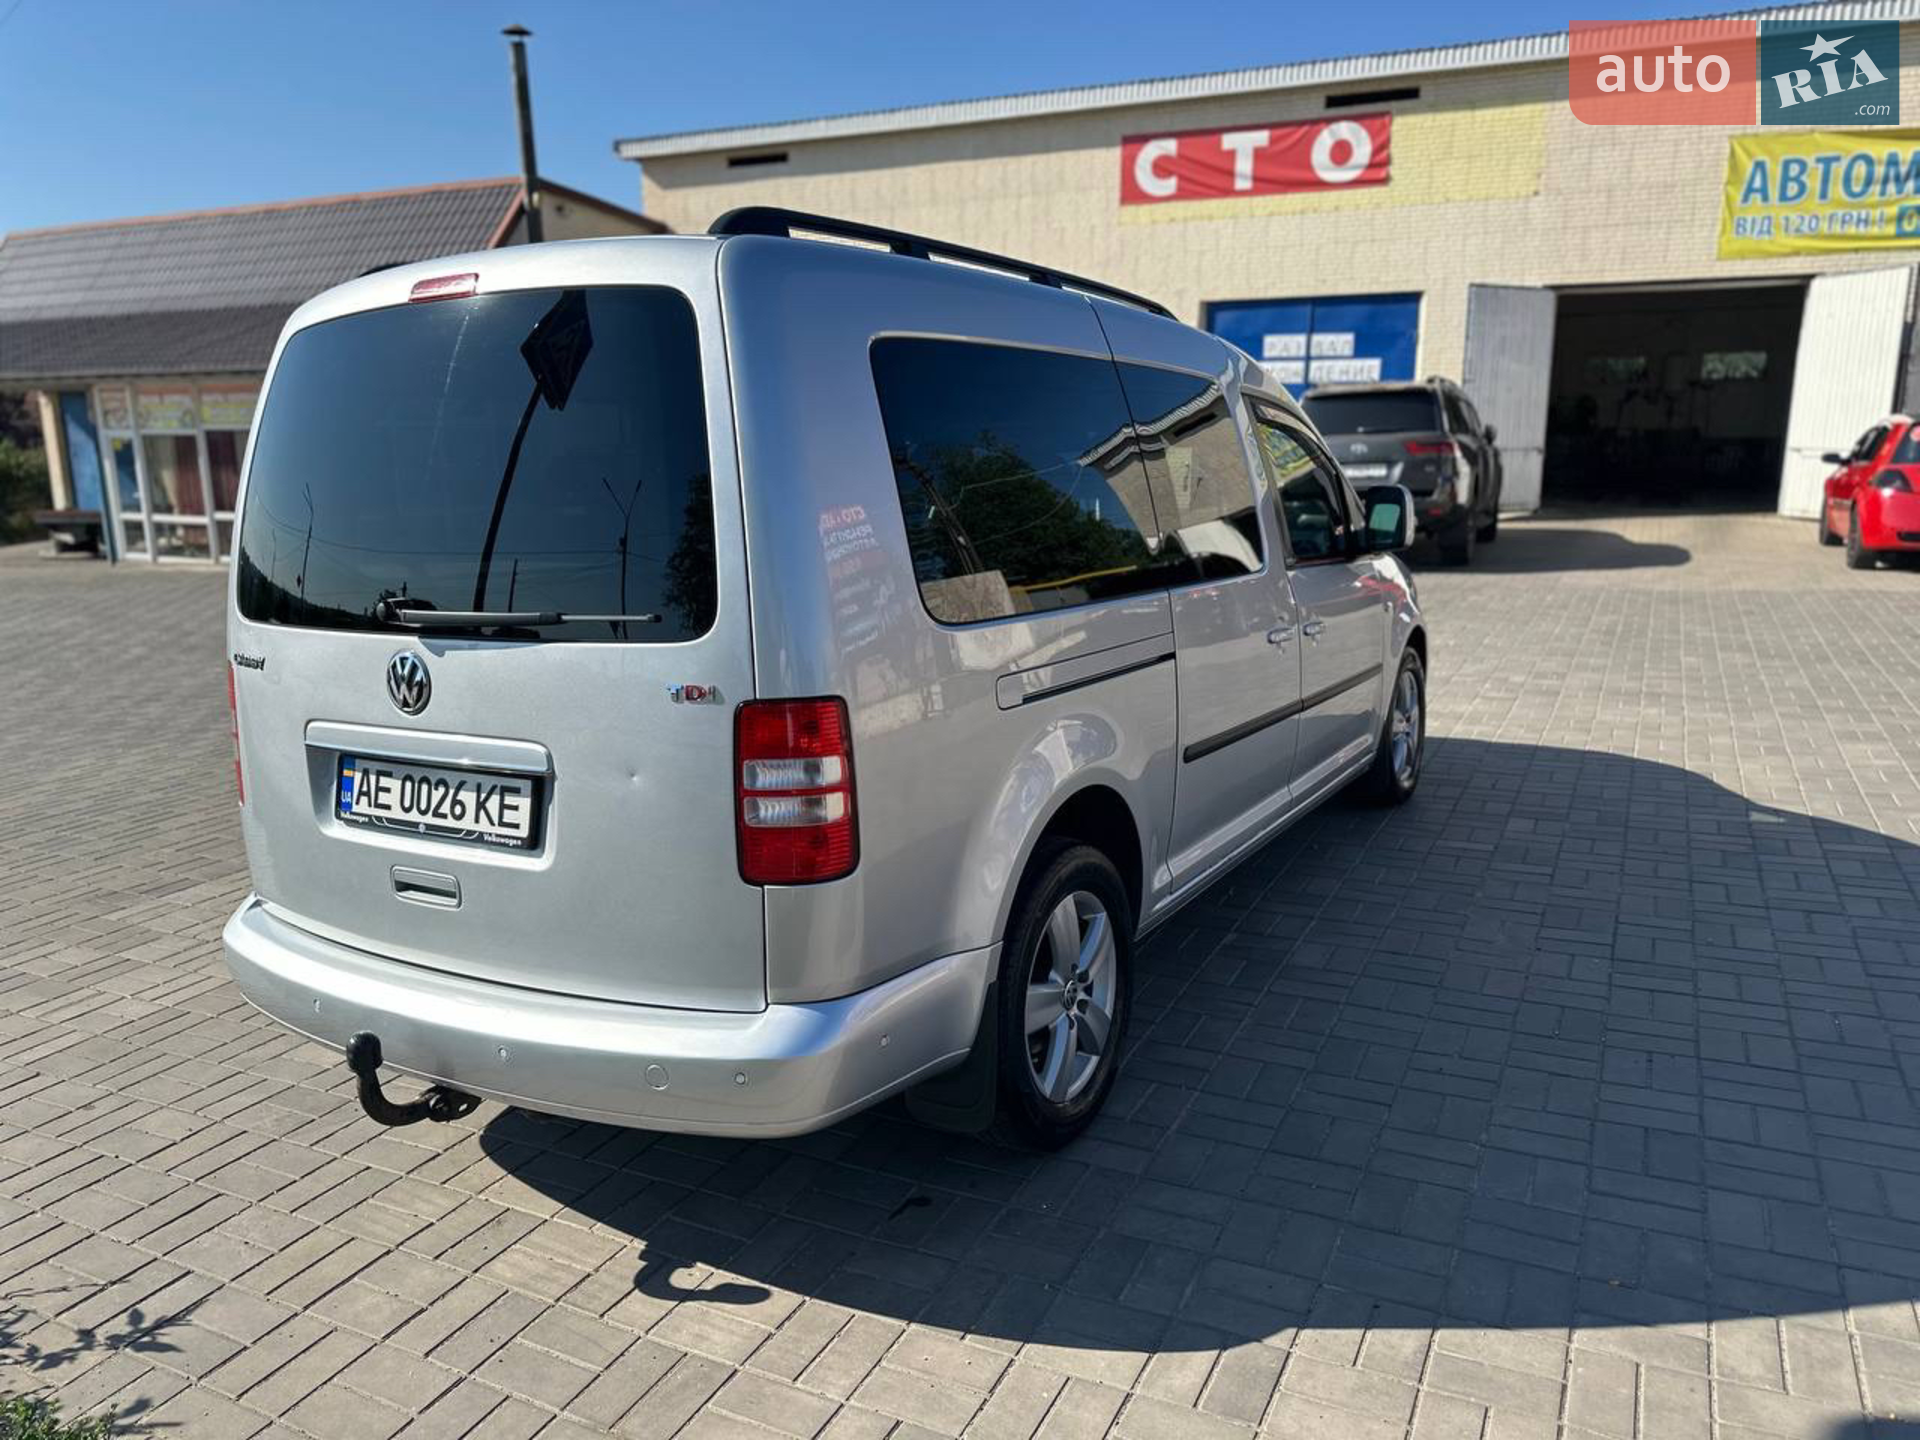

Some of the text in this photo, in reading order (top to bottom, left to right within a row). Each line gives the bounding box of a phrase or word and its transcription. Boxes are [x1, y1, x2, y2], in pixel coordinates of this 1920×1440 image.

[1134, 119, 1372, 197] СТО
[1733, 215, 1774, 237] ВІД
[1782, 212, 1821, 233] 120
[355, 768, 522, 830] AE 0026 KE
